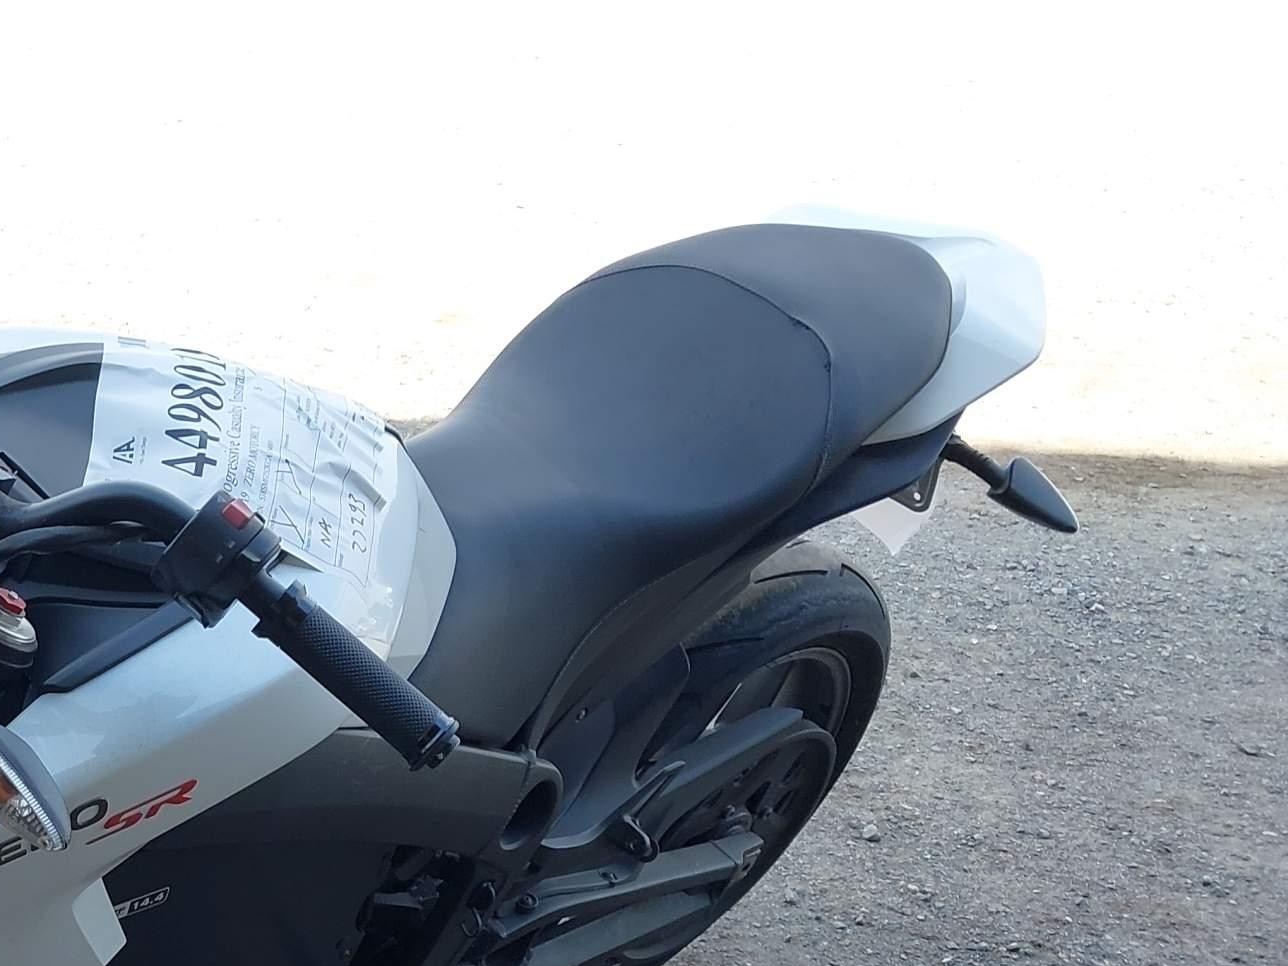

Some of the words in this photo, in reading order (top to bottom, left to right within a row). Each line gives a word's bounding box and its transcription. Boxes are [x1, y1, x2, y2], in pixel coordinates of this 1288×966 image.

[223, 439, 241, 496] ogressive
[244, 460, 258, 488] ZERO
[103, 779, 198, 830] SR
